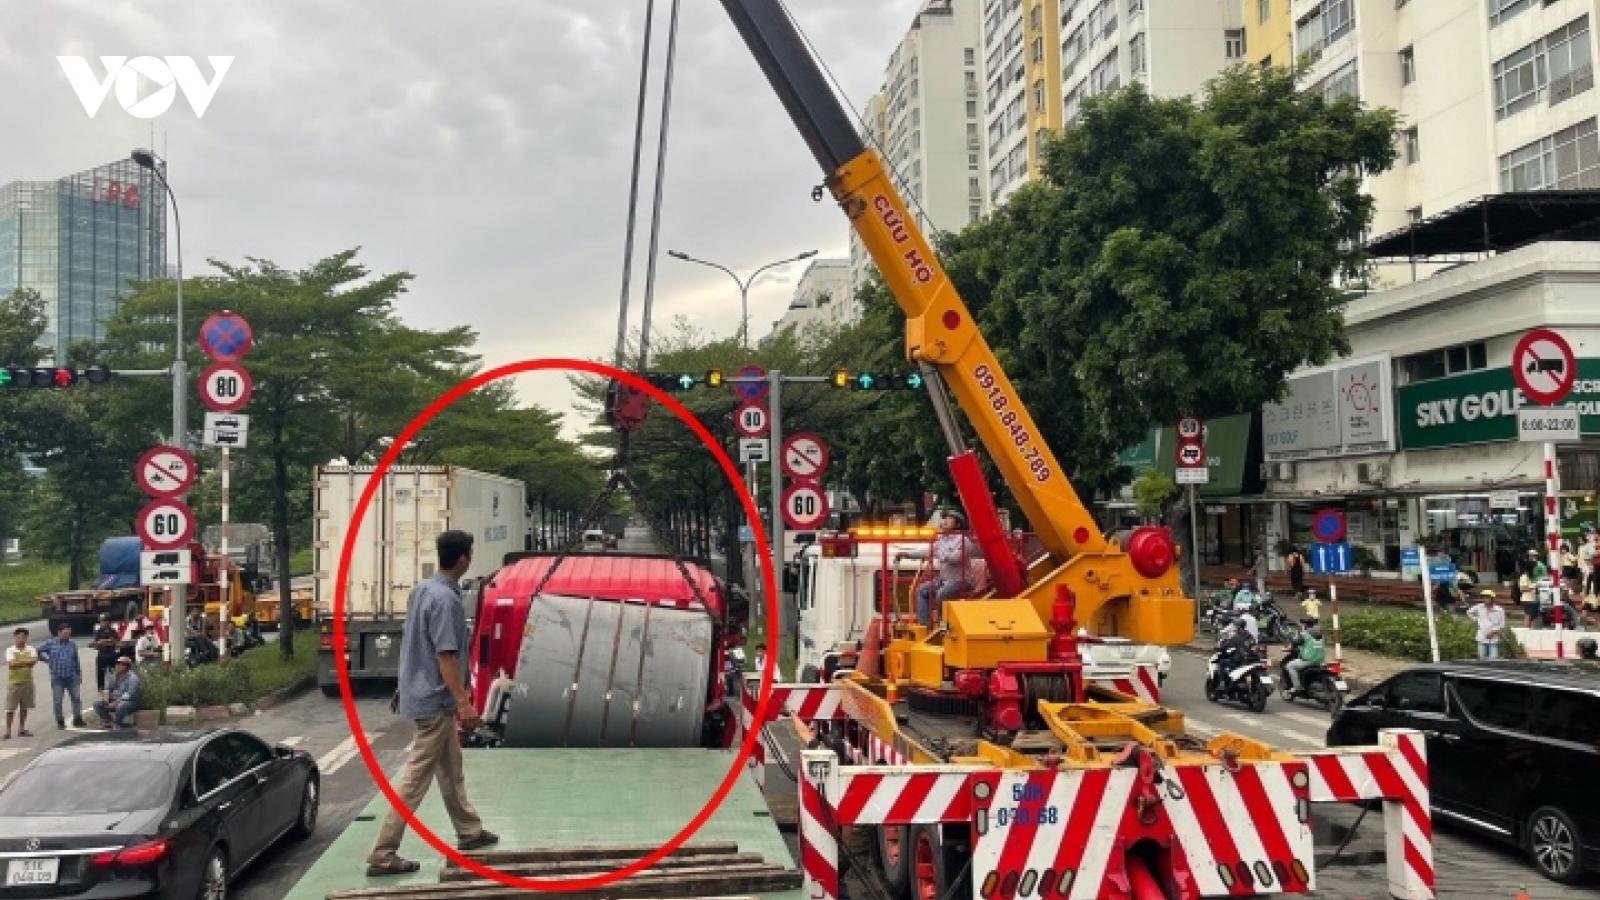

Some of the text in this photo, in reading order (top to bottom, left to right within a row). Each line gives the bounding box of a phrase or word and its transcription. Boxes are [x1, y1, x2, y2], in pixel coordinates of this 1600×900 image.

[872, 194, 934, 285] CỨU HỘ
[215, 376, 237, 398] 80
[744, 411, 761, 427] 80
[974, 364, 1050, 482] 0918.848.789
[1416, 397, 1458, 427] SKY
[1521, 418, 1576, 431] 6:00-22:00
[795, 496, 814, 515] 60
[153, 513, 179, 536] 60
